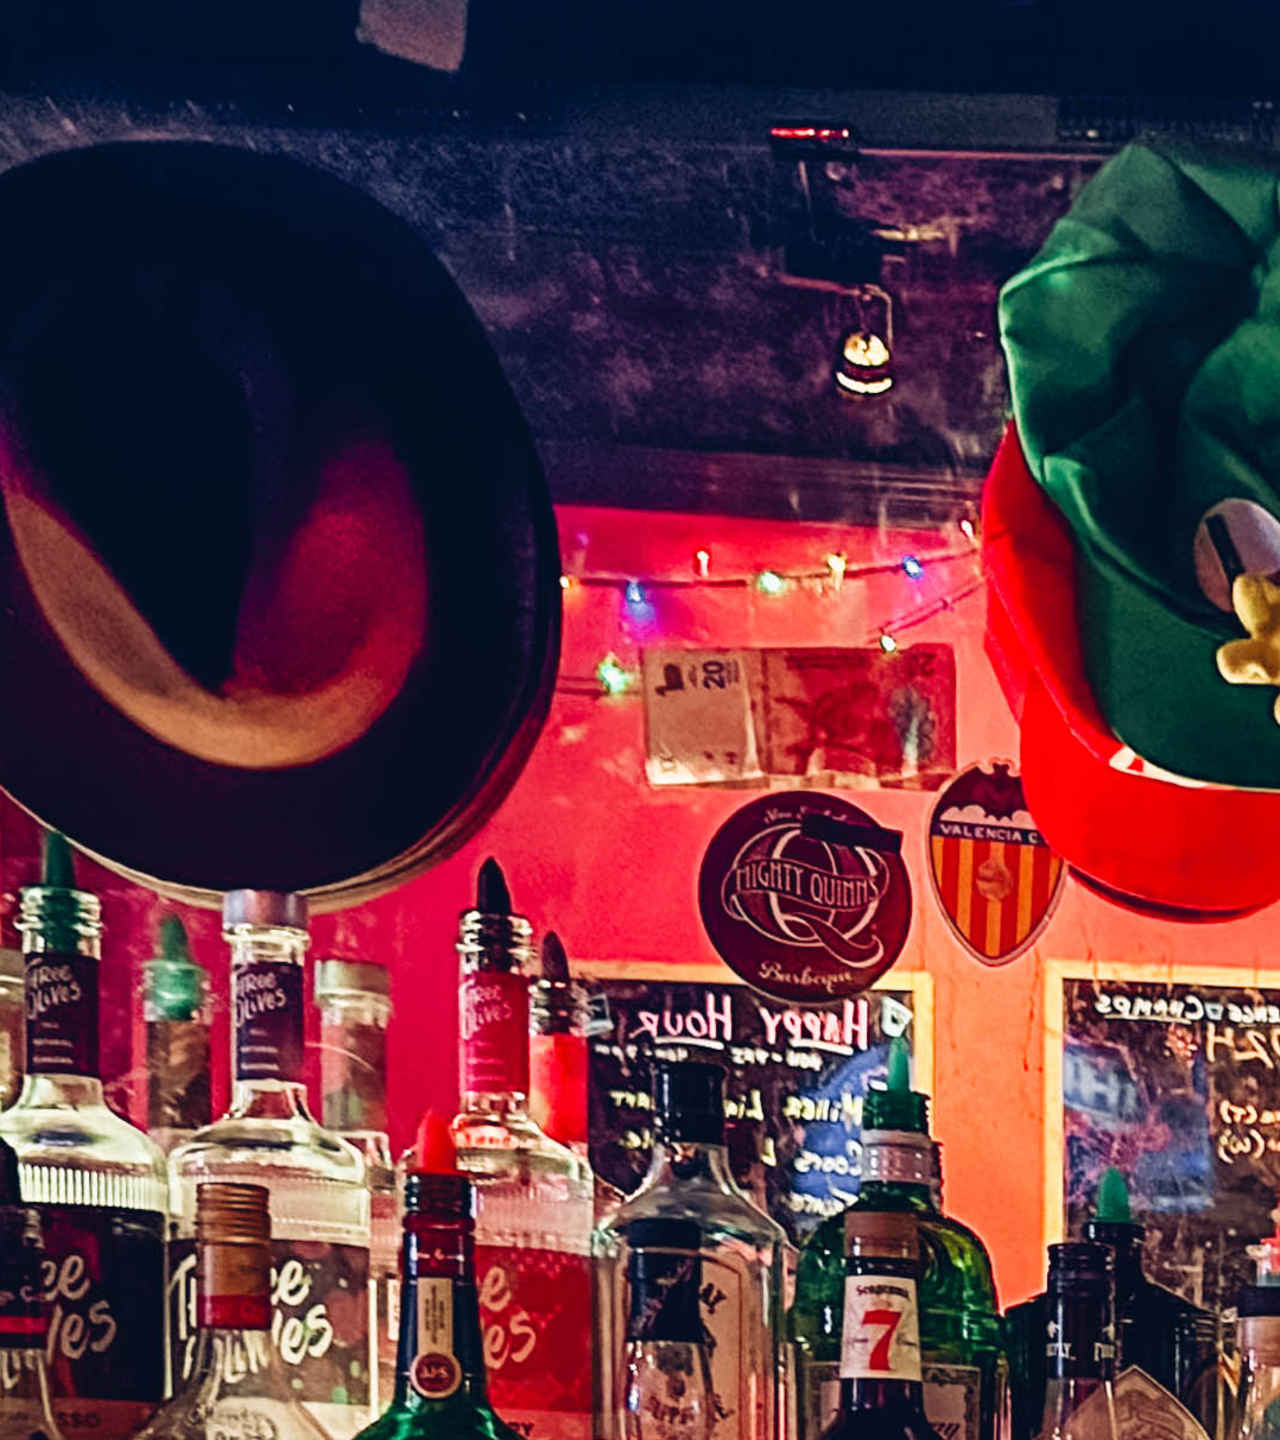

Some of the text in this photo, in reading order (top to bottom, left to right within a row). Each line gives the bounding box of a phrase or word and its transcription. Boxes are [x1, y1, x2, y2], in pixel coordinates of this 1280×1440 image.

[940, 824, 1022, 841] VALENCIA
[736, 863, 803, 893] MIGHTY
[862, 1309, 903, 1371] 7
